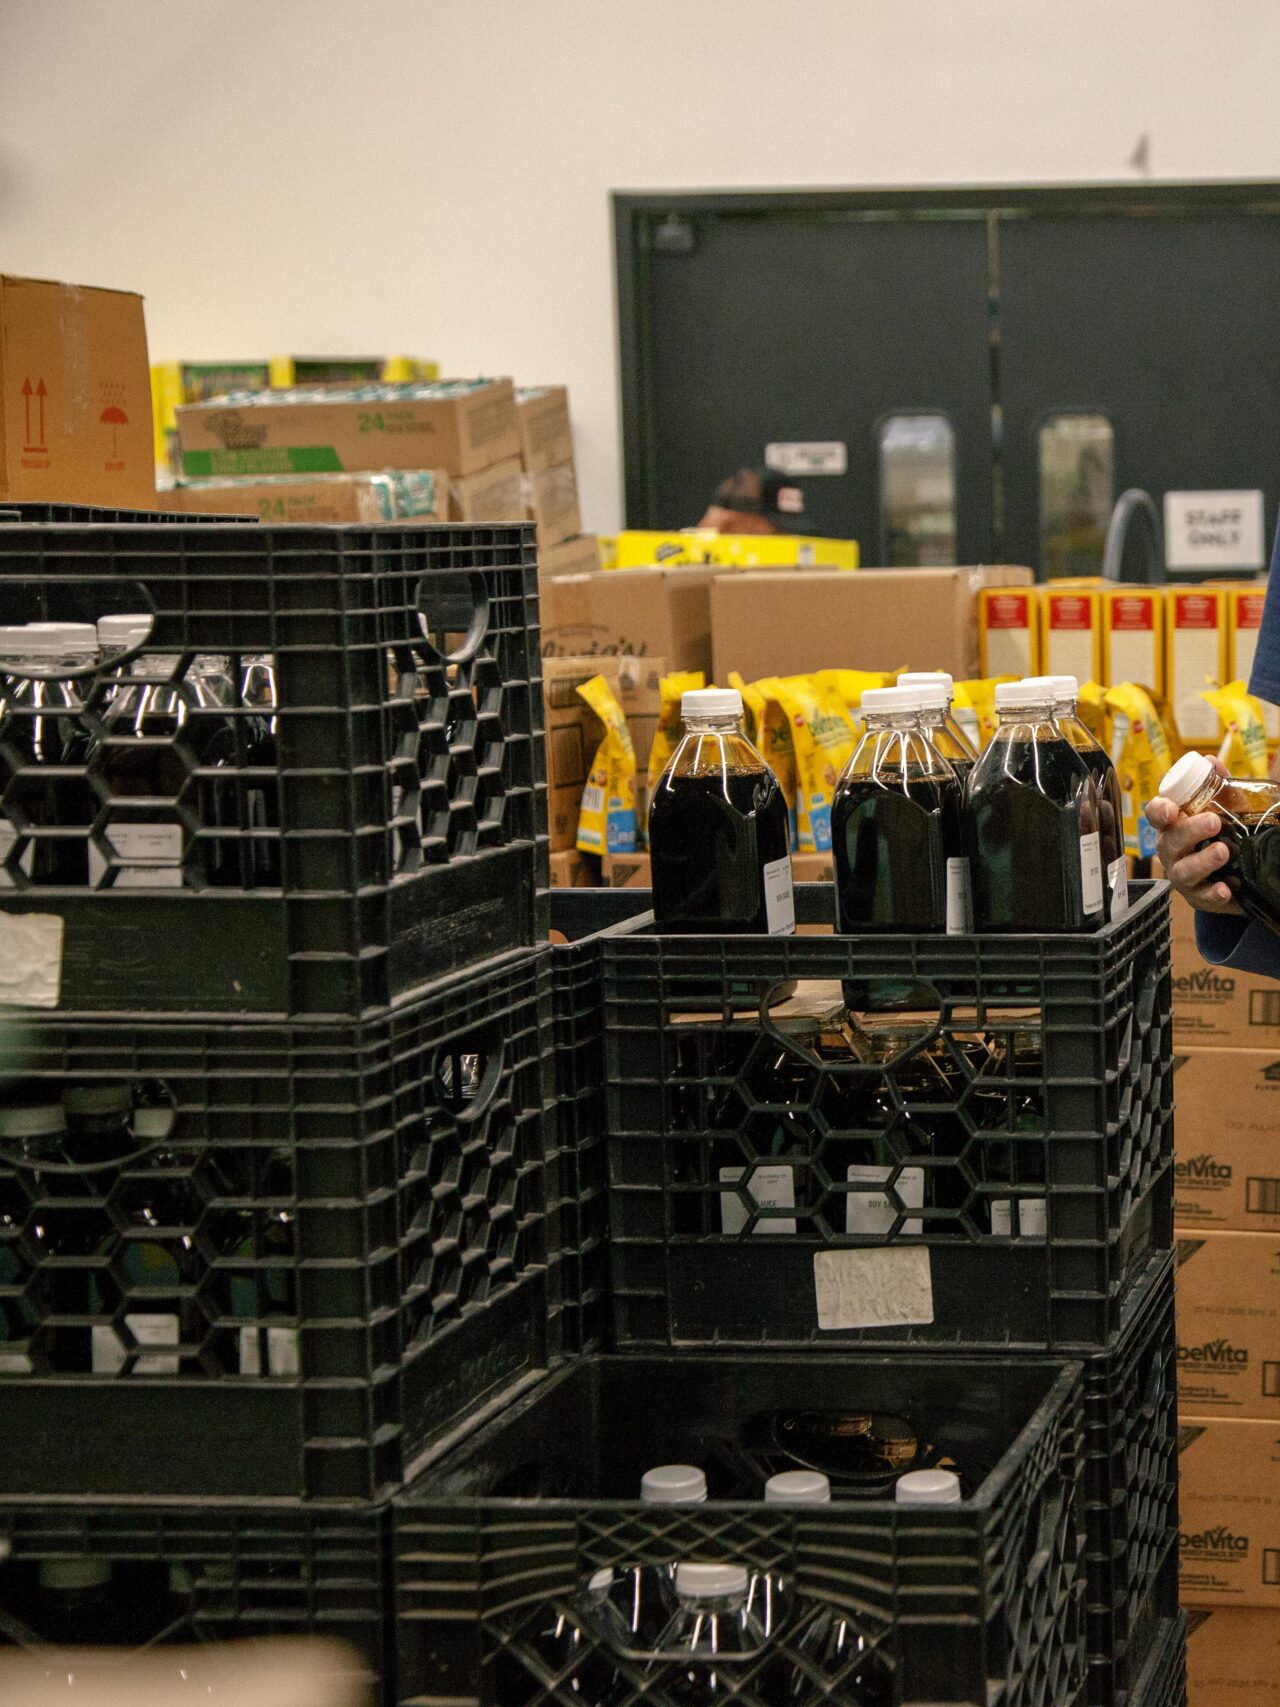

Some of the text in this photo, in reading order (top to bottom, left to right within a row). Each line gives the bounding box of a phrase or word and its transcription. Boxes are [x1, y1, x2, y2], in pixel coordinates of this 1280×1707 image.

[259, 497, 285, 520] 24
[1184, 508, 1242, 526] STAFF
[1187, 529, 1241, 547] ONLY
[1174, 1154, 1232, 1179] elVita
